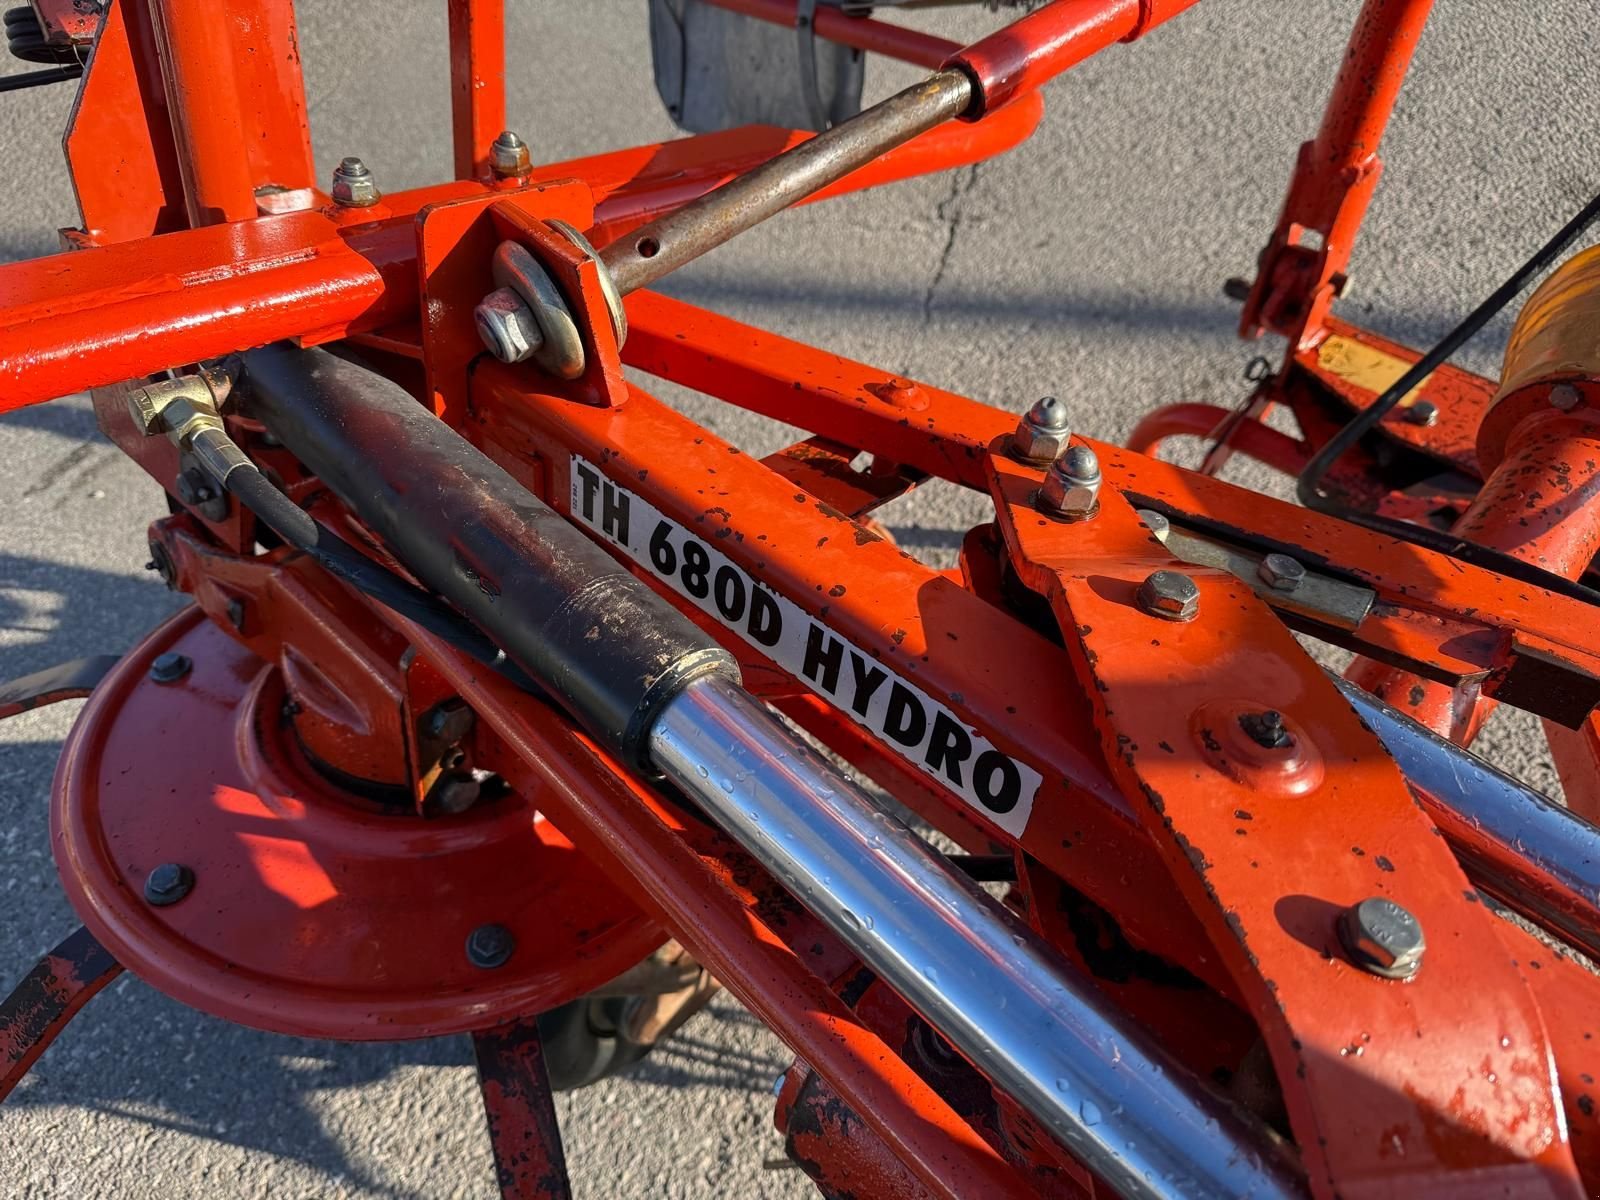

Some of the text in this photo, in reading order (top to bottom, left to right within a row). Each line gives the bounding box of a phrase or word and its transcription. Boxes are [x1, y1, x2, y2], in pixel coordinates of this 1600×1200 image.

[577, 462, 1022, 814] TH 680D HYDRO
